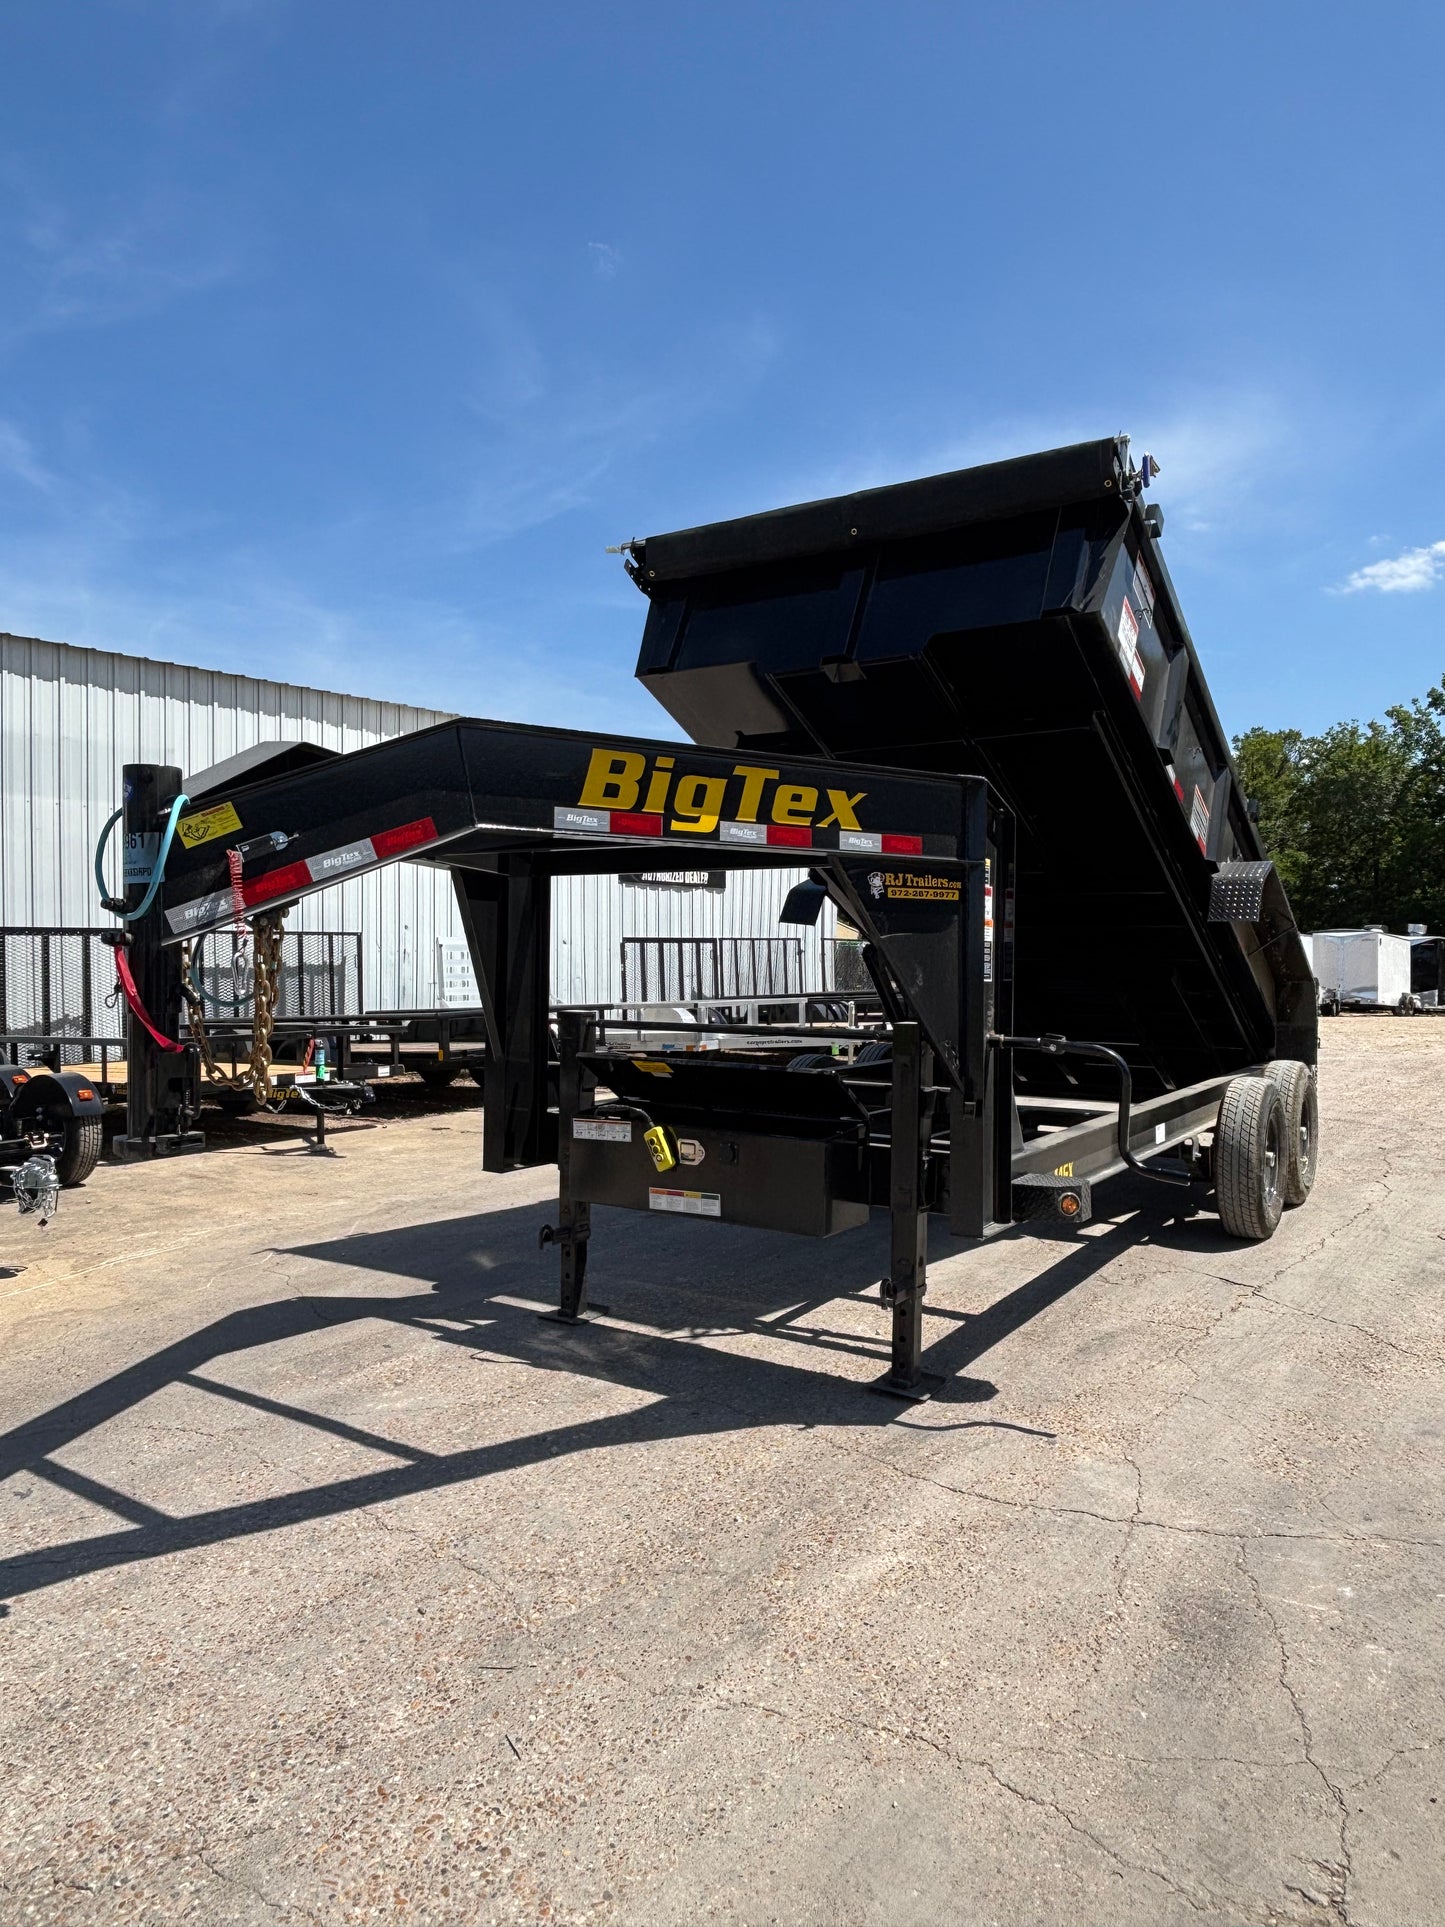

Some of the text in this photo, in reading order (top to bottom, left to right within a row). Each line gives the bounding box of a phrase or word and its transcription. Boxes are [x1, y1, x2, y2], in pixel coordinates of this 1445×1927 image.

[577, 748, 868, 833] BigTex
[566, 813, 598, 825] BigTex
[730, 827, 757, 838] BigTex
[849, 837, 873, 847] BigTex
[323, 851, 360, 868] BigTex
[885, 872, 904, 886] RJ
